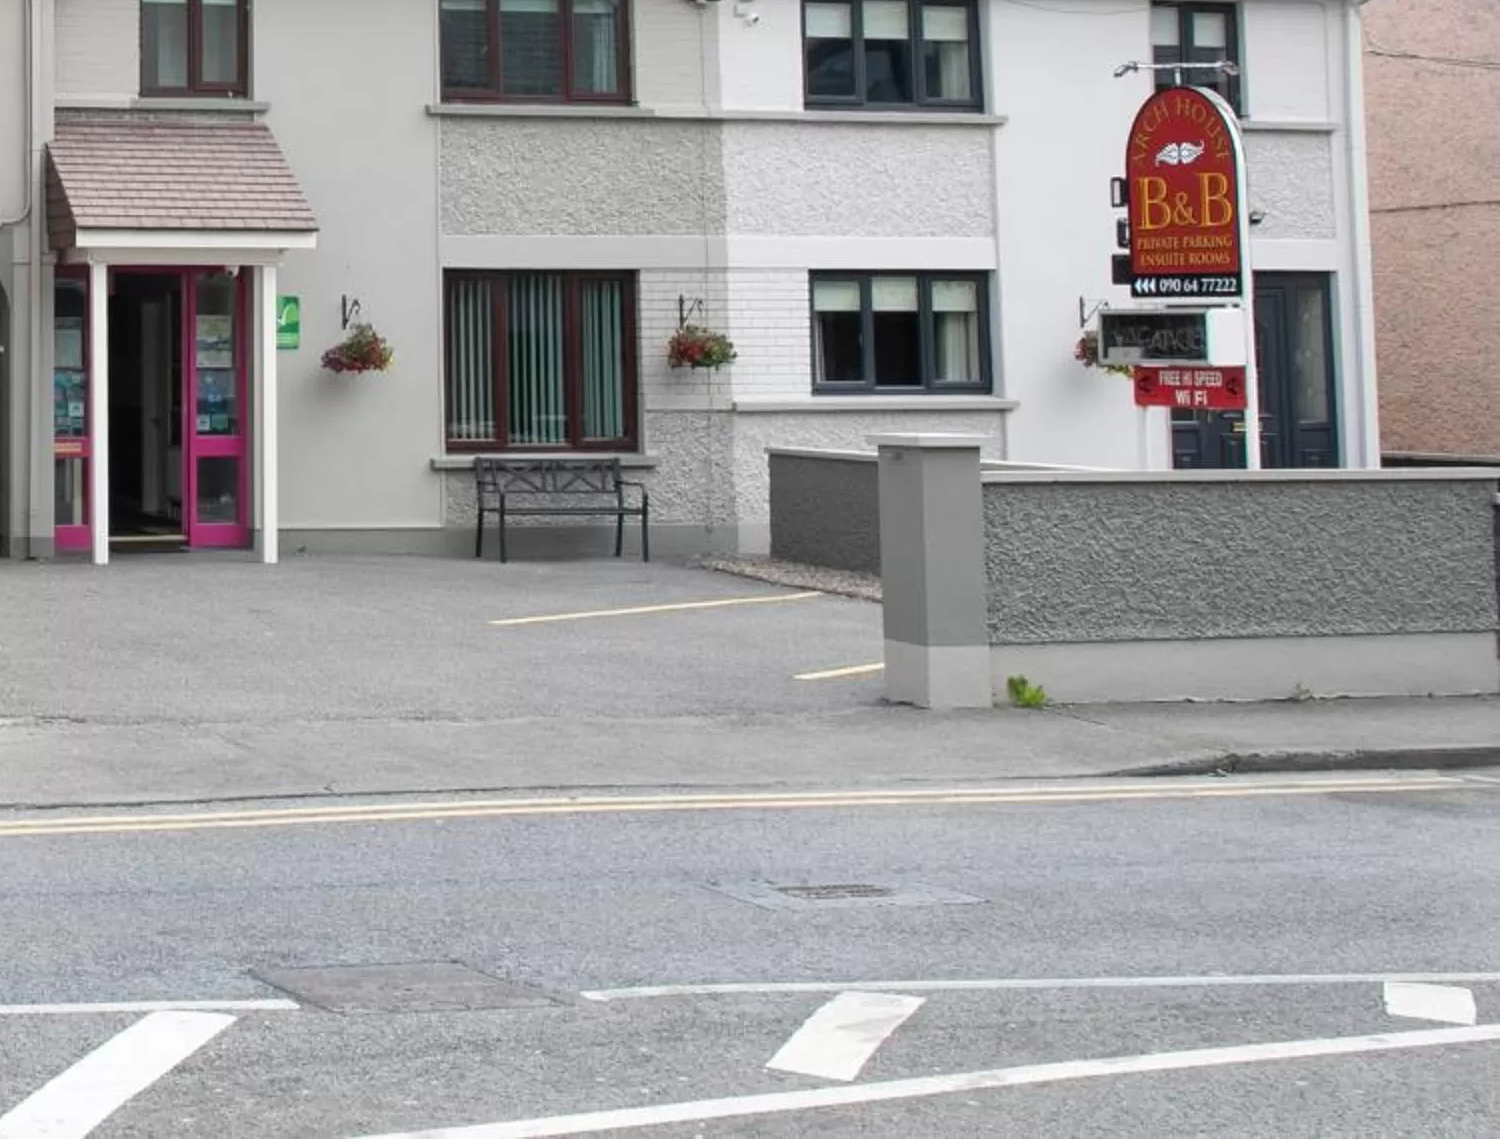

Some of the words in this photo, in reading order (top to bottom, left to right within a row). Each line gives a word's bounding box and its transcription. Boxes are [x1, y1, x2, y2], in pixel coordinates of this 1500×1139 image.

[1132, 100, 1169, 165] ARCH
[1176, 96, 1229, 158] HOUSE
[1136, 172, 1233, 230] B&B
[1137, 236, 1180, 250] PRIVATE
[1183, 234, 1232, 248] PARKING
[1189, 250, 1231, 265] ROOMS
[1159, 278, 1181, 292] 090
[1183, 279, 1198, 292] 64
[1201, 277, 1237, 292] 77222
[1159, 370, 1181, 386] FREE
[1193, 370, 1222, 386] SPEED
